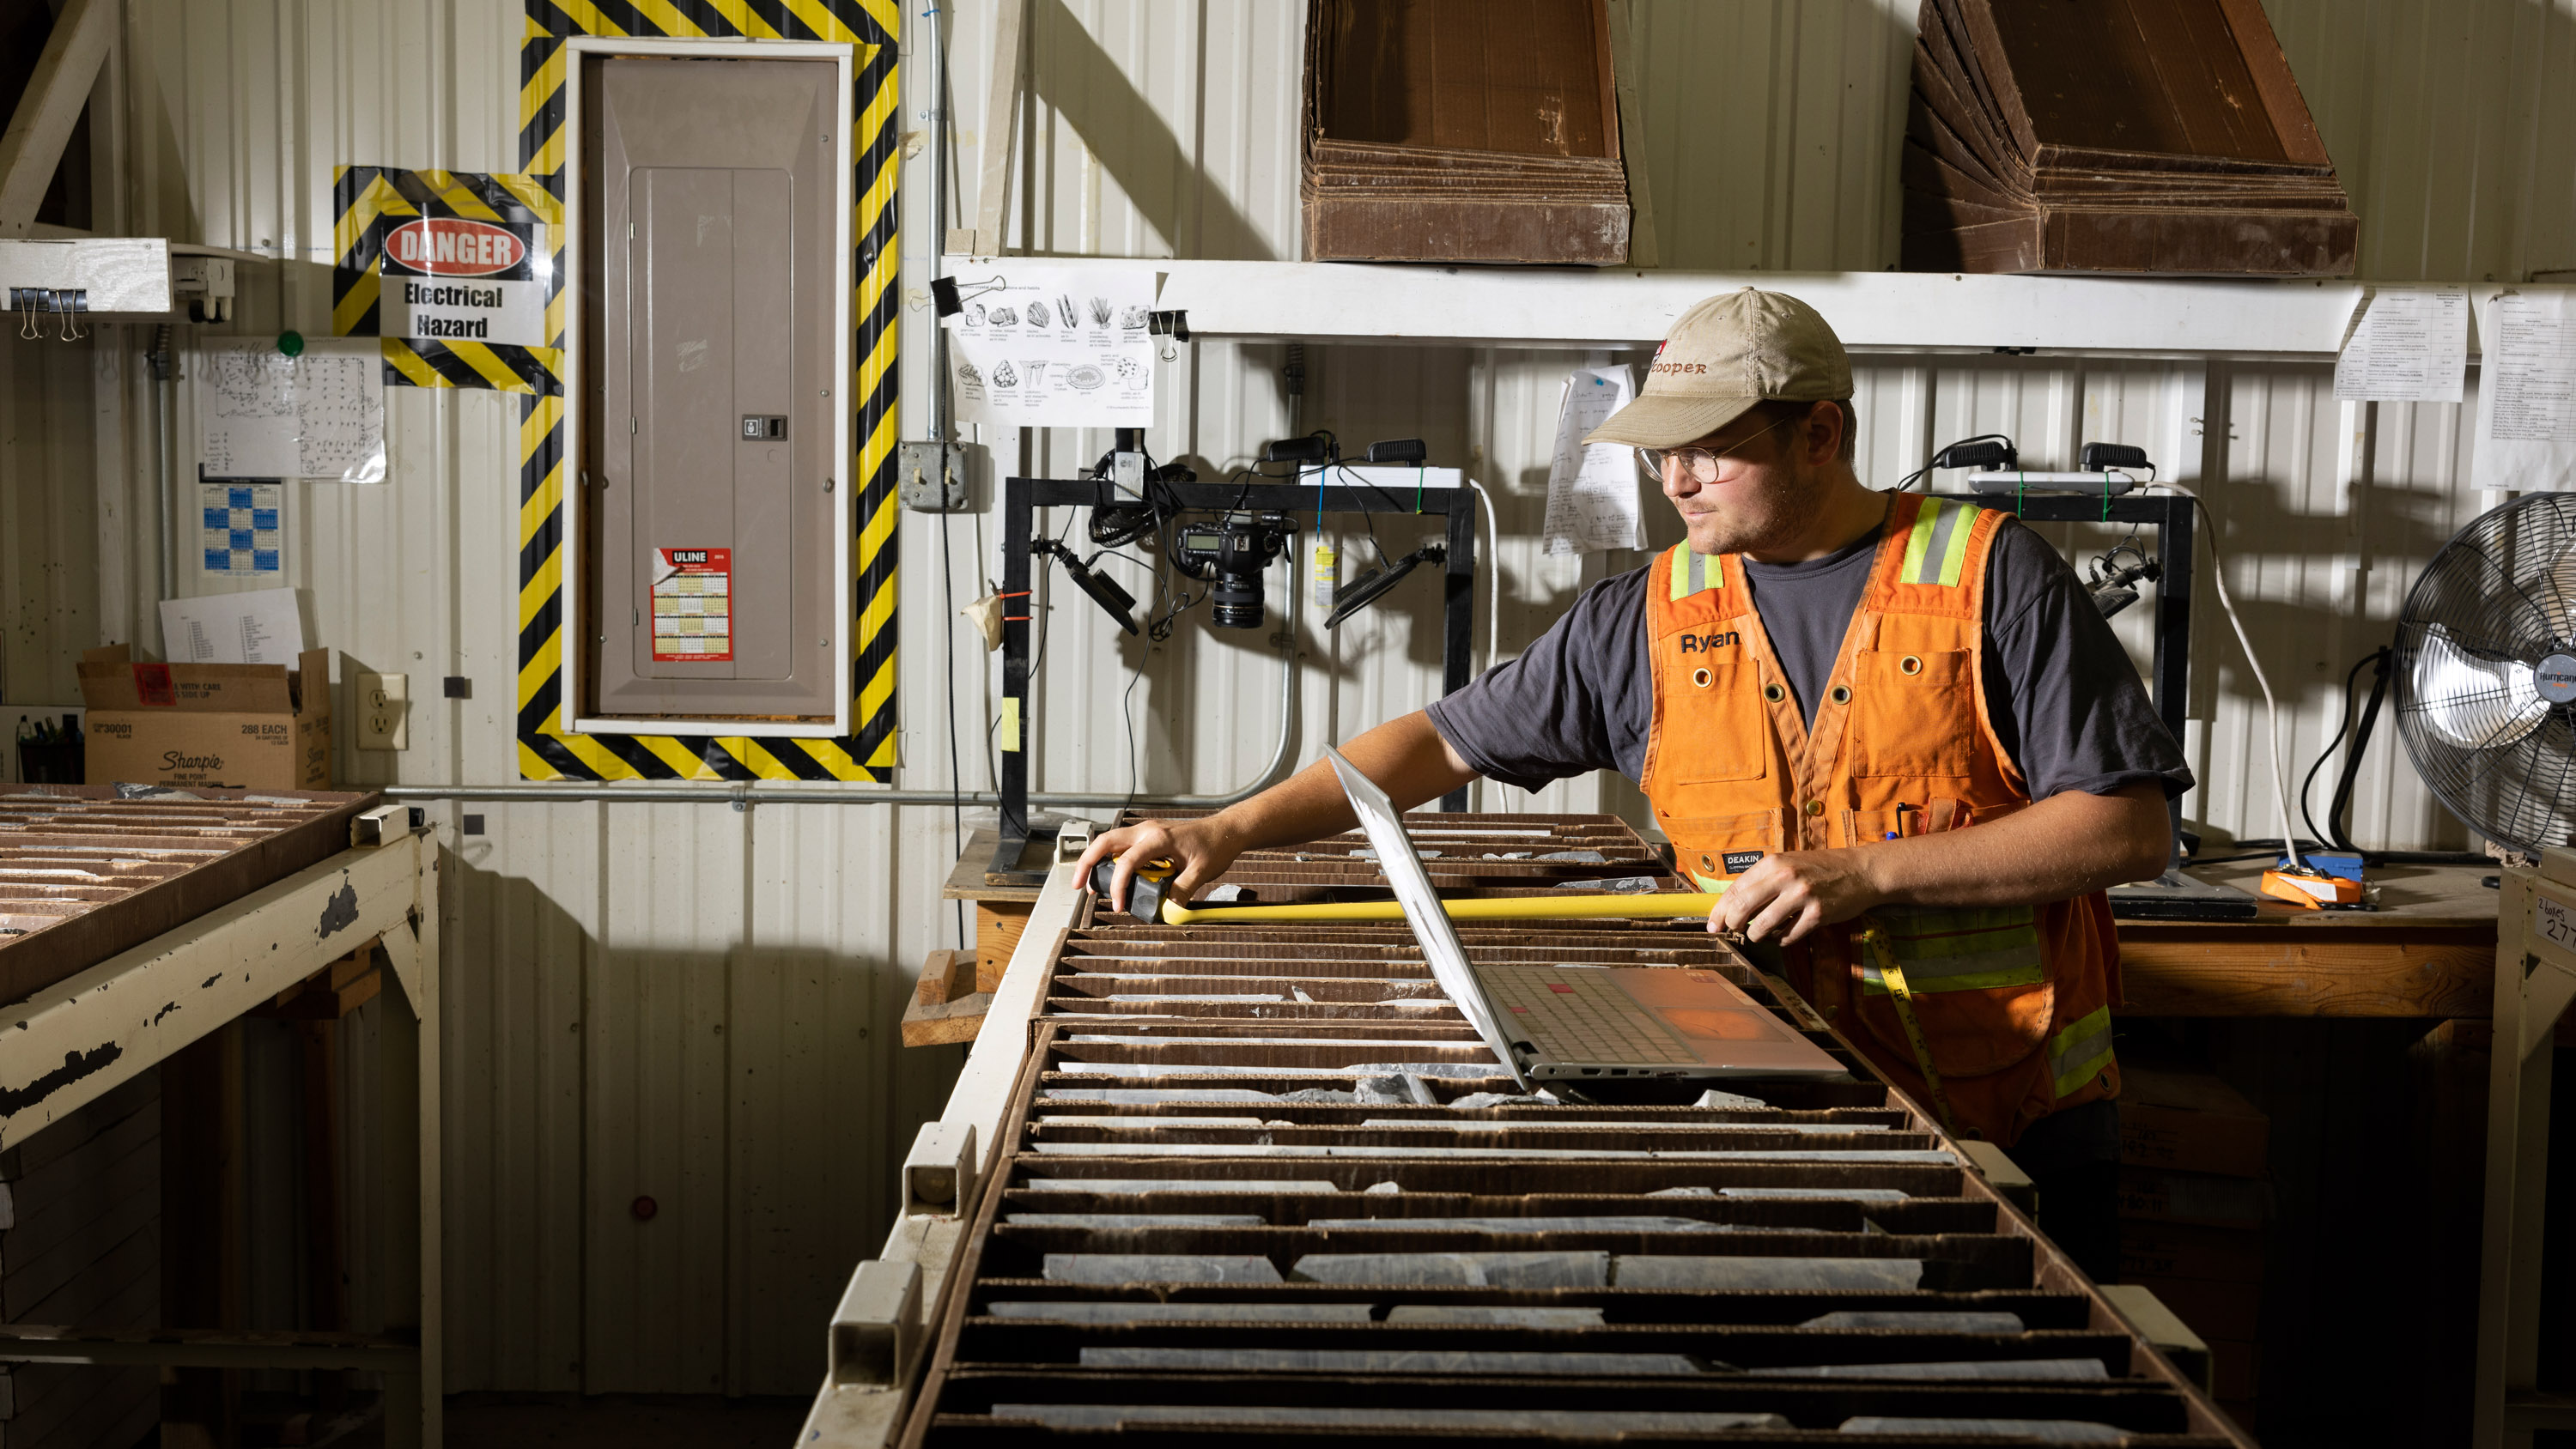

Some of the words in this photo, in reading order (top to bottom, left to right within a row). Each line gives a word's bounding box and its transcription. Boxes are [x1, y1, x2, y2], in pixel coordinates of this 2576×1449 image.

[400, 230, 512, 266] DANGER
[404, 282, 502, 307] Electrical
[416, 314, 488, 338] Hazard
[674, 552, 706, 562] ULINE
[1680, 631, 1740, 653] Ryan
[2540, 671, 2576, 683] Hurrican
[104, 724, 132, 733] 30001
[241, 724, 259, 734] 288
[262, 724, 288, 735] EACH
[158, 750, 222, 772] Sharpie
[1728, 854, 1759, 864] DEAKIN
[2538, 898, 2543, 909] 2
[2544, 900, 2565, 922] boxes
